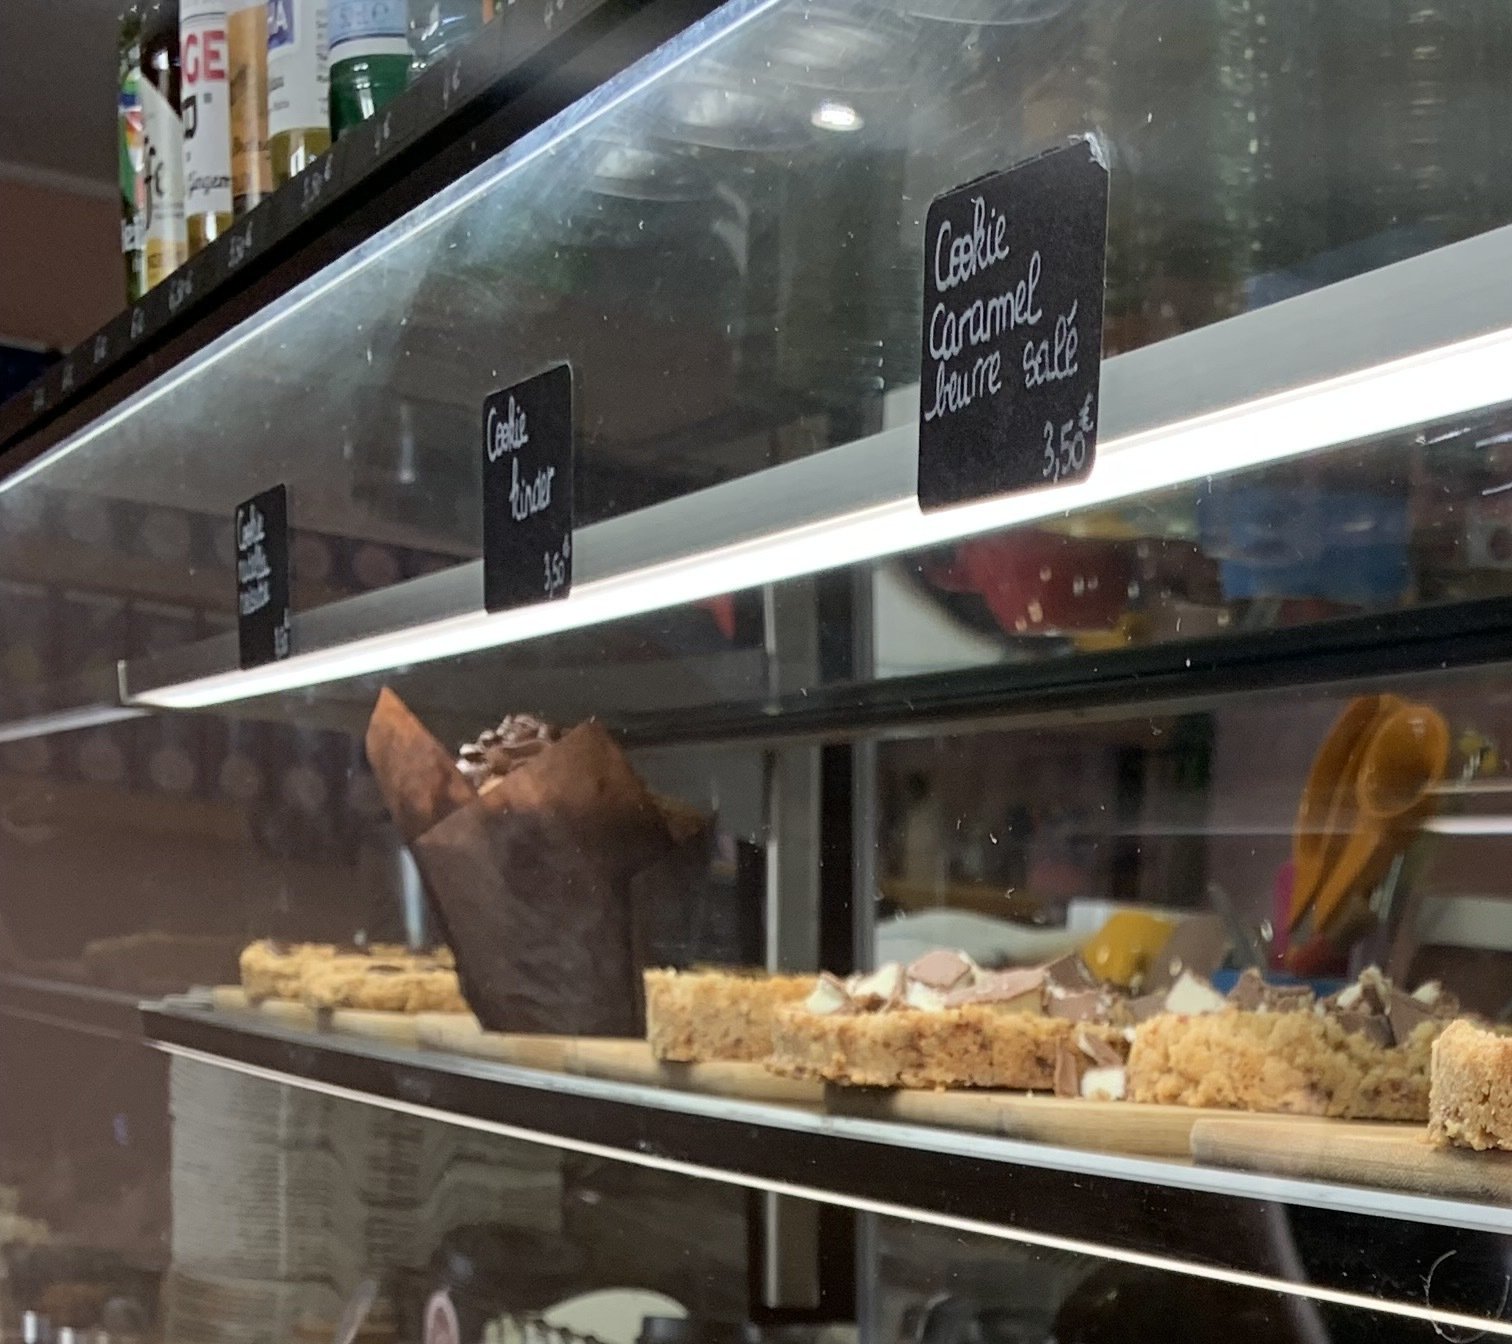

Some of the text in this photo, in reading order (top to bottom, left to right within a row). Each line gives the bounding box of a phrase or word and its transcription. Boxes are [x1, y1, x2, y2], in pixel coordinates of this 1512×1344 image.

[935, 196, 1010, 292] Cookie
[925, 299, 1079, 421] beurre salé
[487, 395, 528, 462] Cookie
